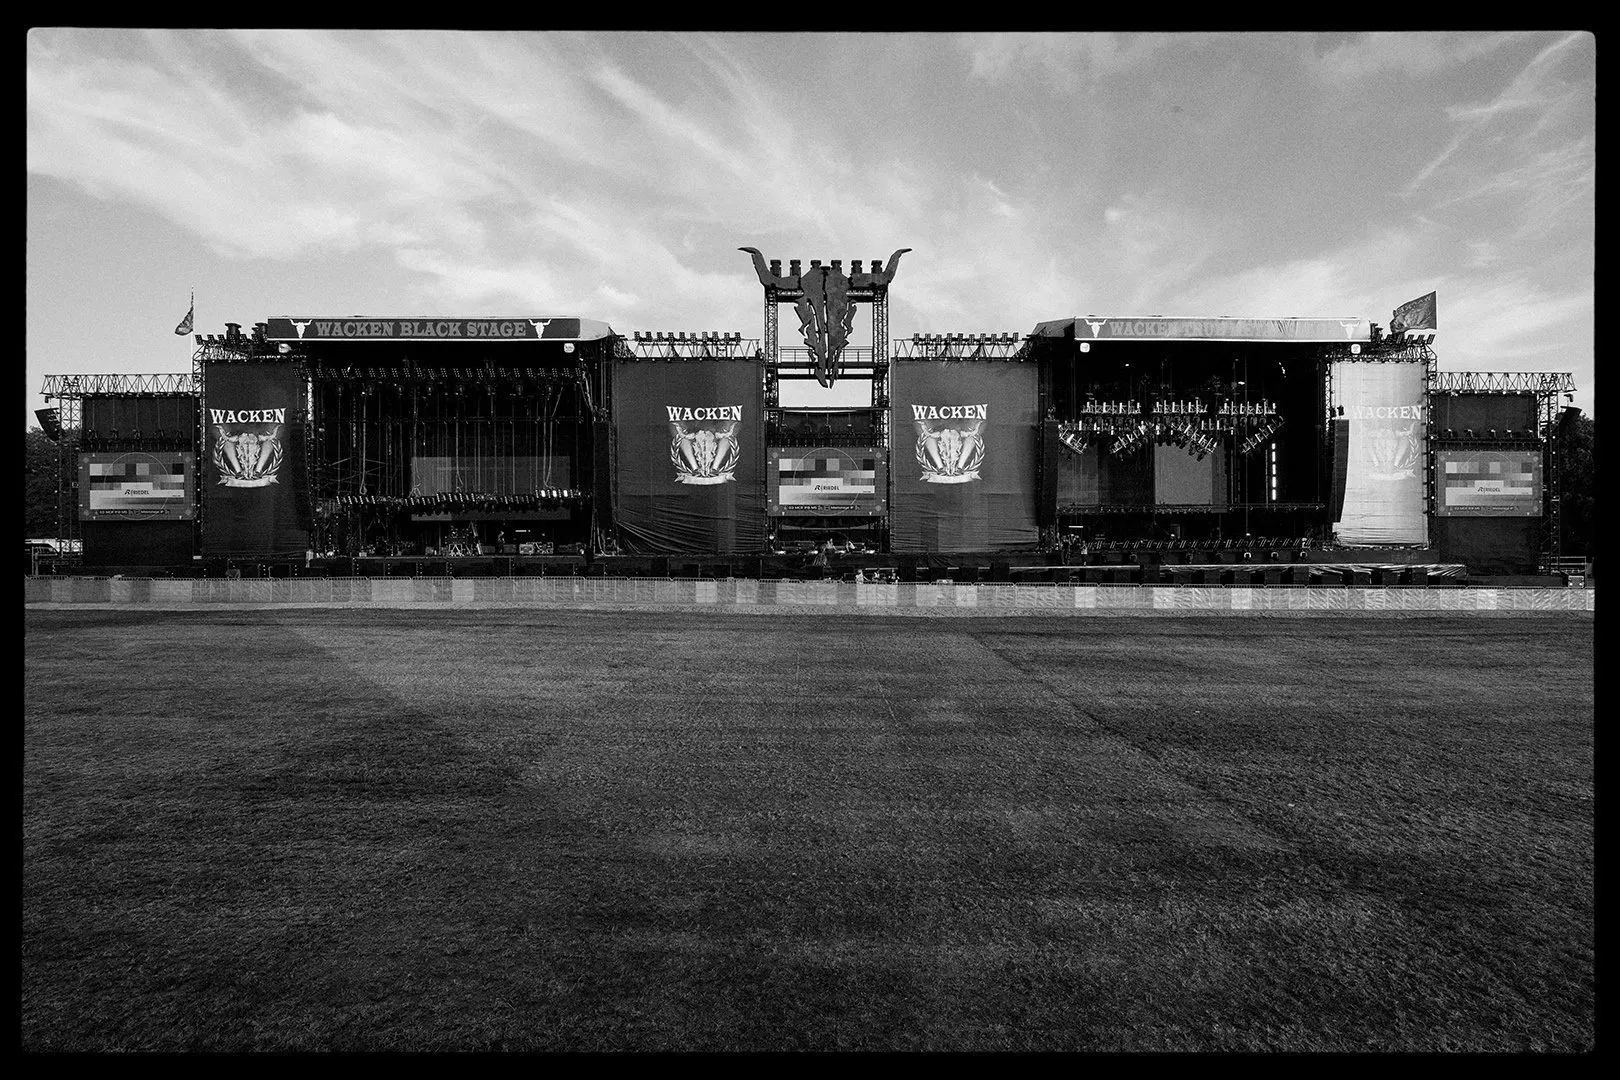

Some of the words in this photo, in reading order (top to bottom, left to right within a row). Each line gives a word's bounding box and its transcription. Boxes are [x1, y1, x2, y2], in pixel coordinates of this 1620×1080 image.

[315, 321, 394, 337] WACKEN
[399, 321, 462, 337] BLACK
[466, 321, 527, 337] STAGE
[209, 407, 286, 424] WACKEN
[666, 405, 743, 422] WACKEN
[911, 404, 988, 420] WACKEN
[1351, 404, 1422, 420] WACKEN
